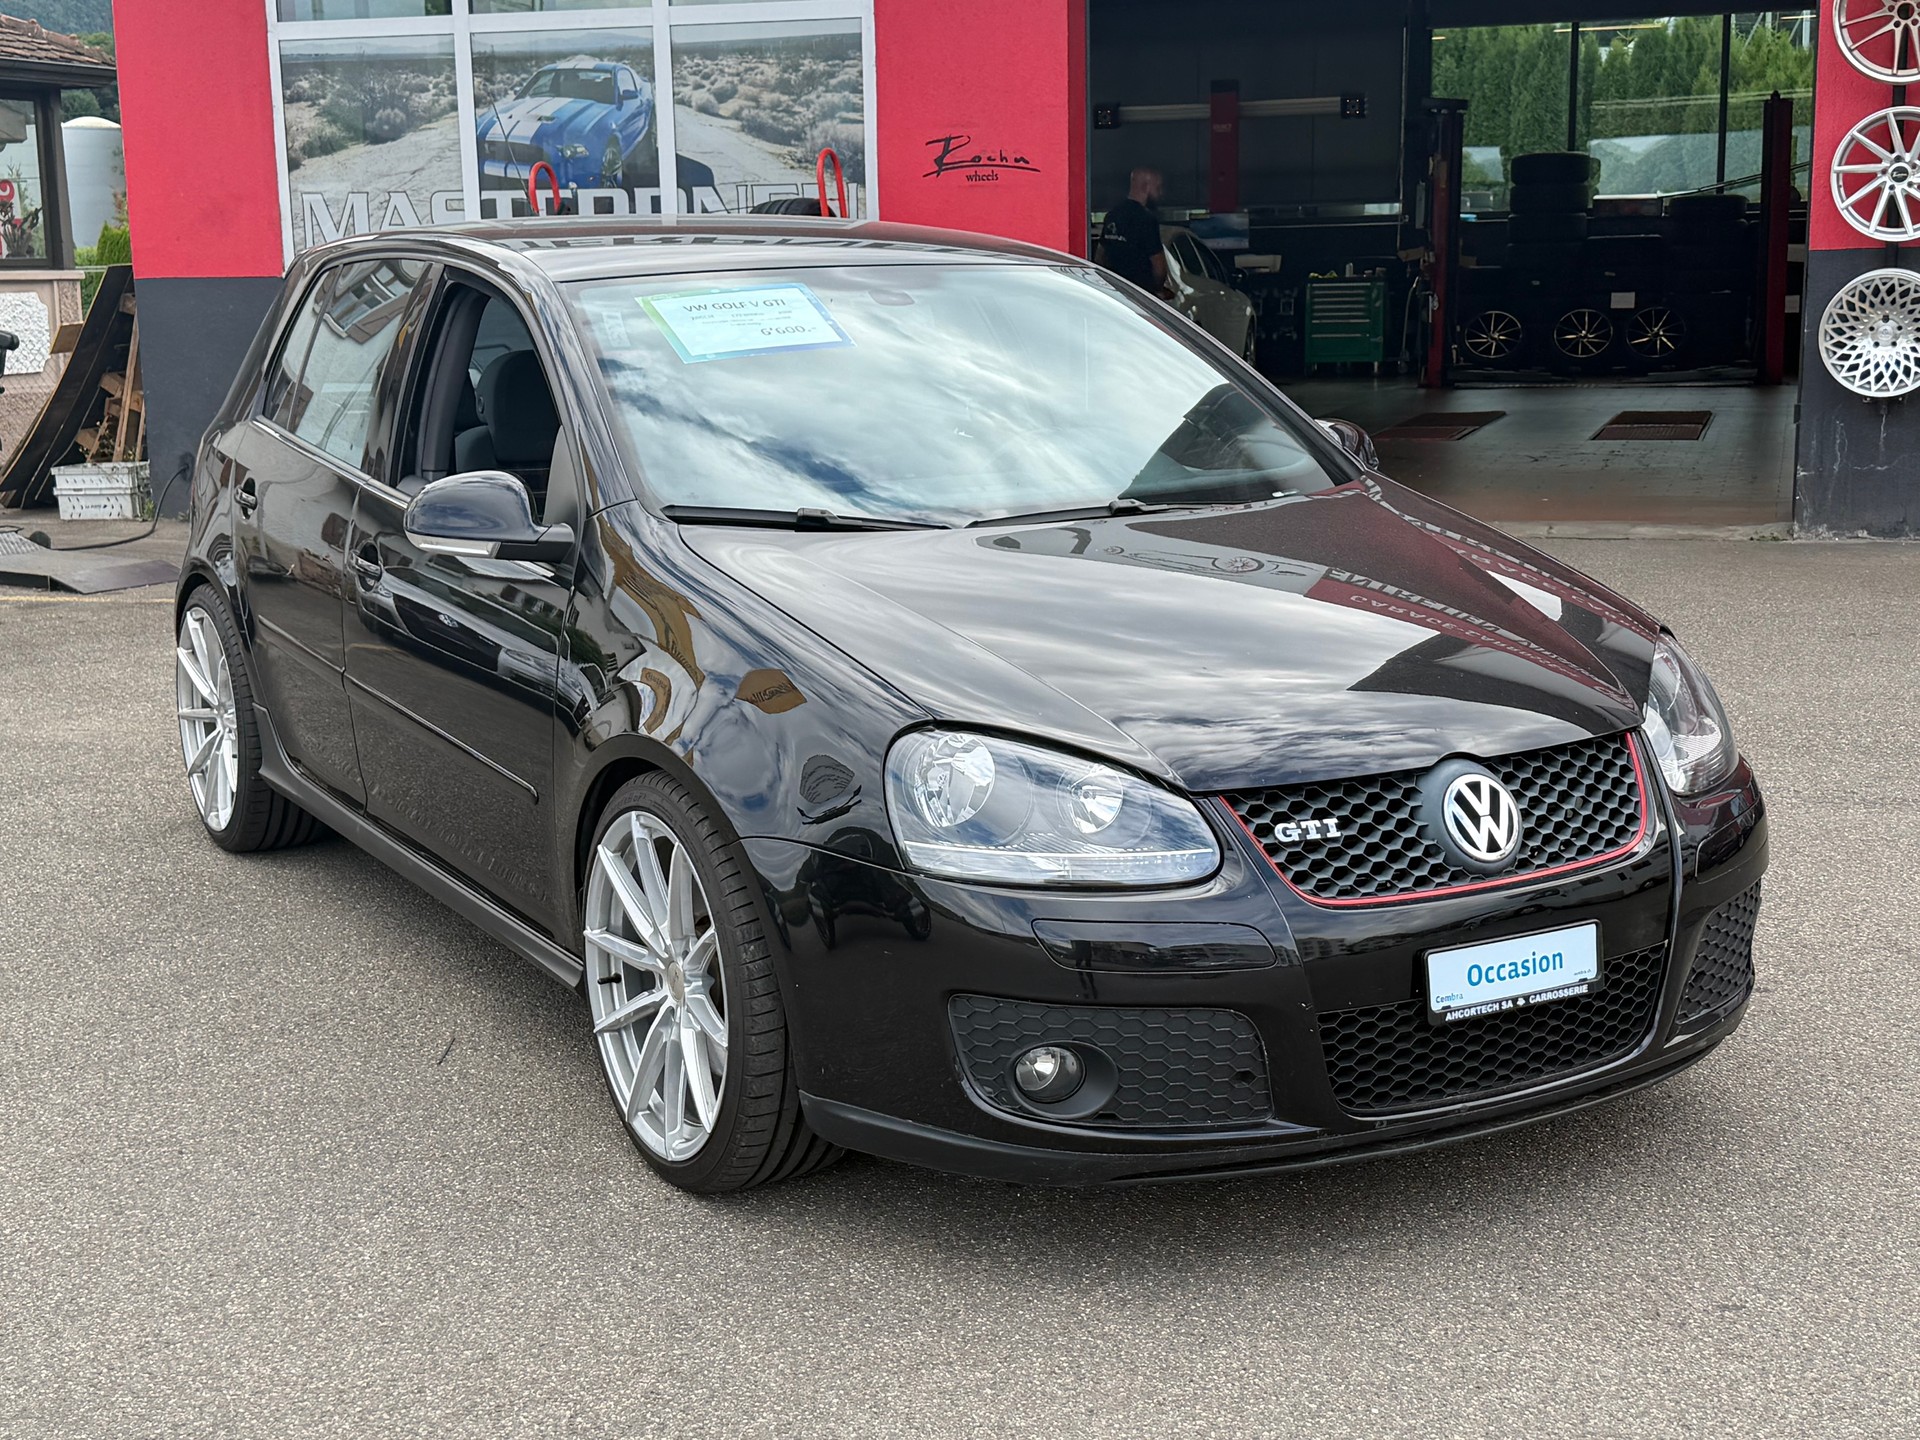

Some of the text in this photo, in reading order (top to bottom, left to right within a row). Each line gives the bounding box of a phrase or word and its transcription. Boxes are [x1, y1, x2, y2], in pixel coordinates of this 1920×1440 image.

[966, 170, 998, 182] wheels
[683, 303, 708, 312] VW
[711, 301, 746, 310] GOLF
[763, 298, 786, 307] GTI
[1274, 818, 1342, 843] GTI
[1467, 951, 1564, 987] Occasion
[1435, 992, 1464, 1004] Cembra
[1445, 984, 1589, 1022] AHCORTECH SA CARROSSERIE
